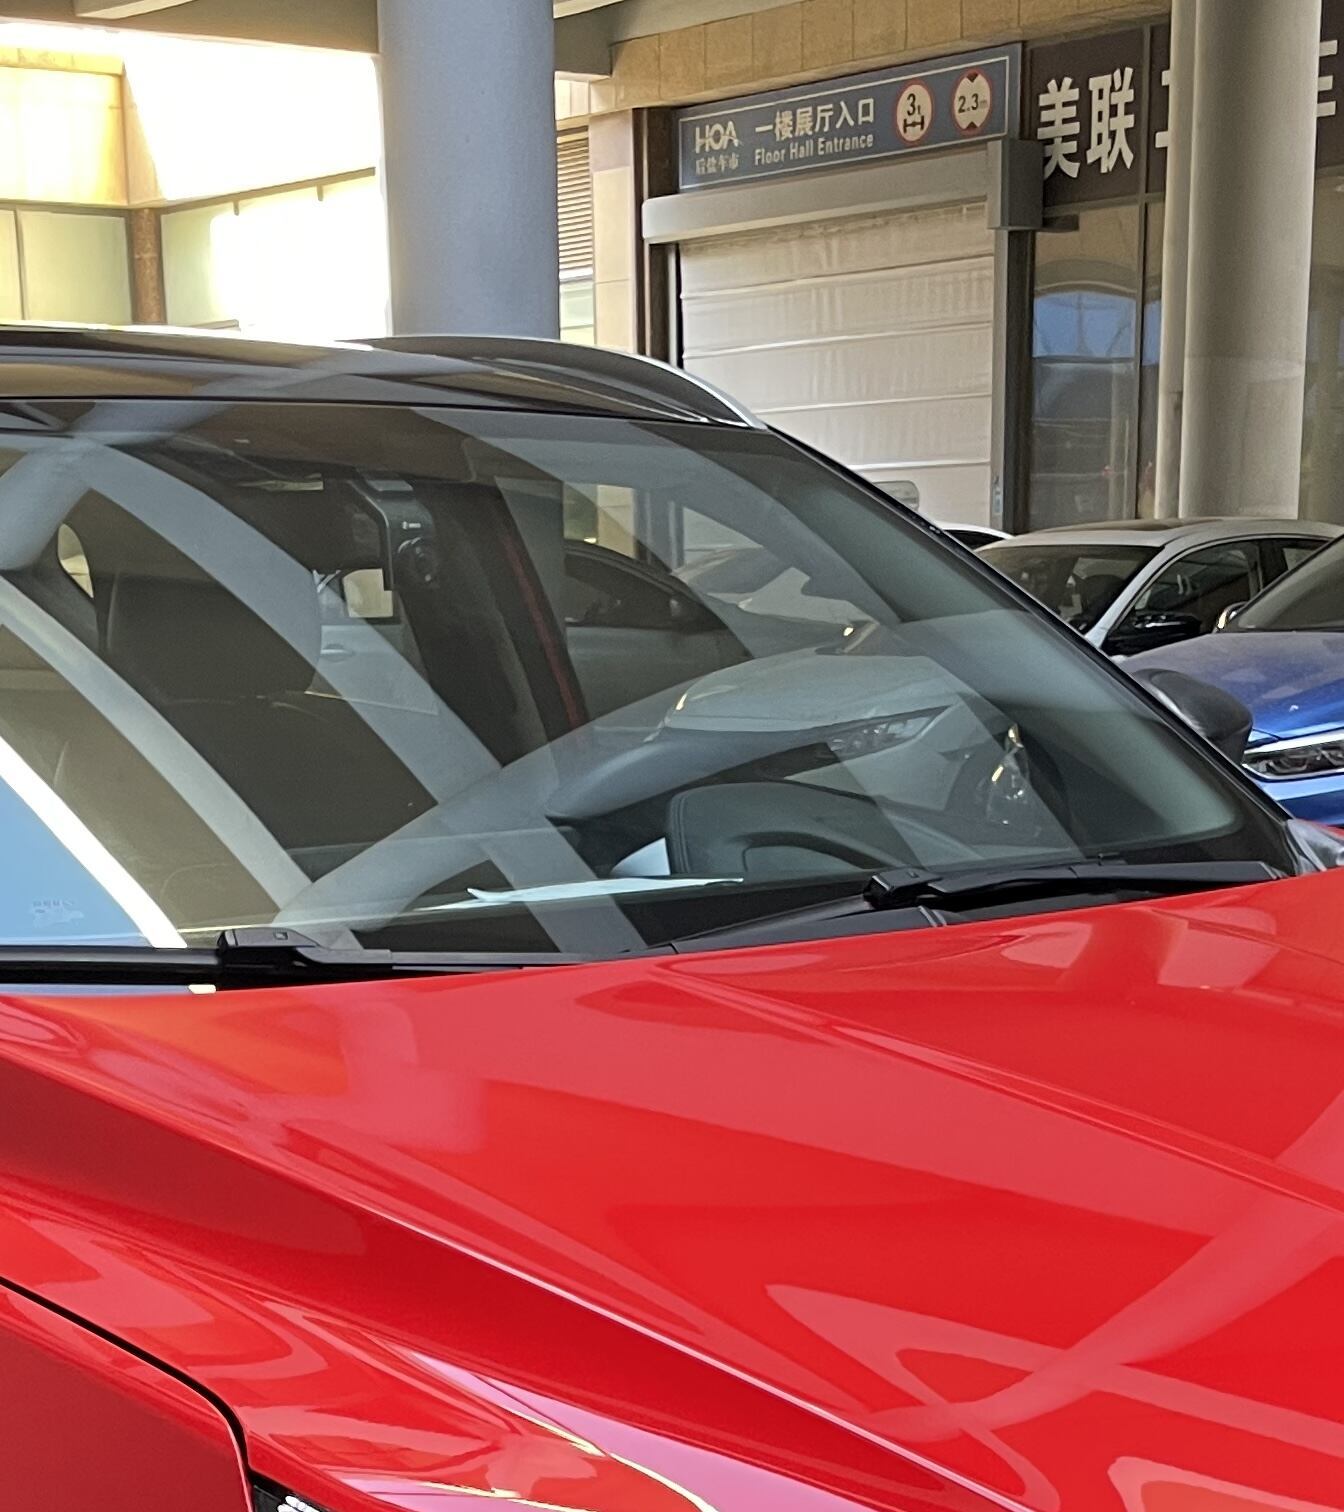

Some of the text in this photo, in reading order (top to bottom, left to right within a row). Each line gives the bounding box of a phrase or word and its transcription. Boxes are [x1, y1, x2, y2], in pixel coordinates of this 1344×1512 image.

[755, 98, 874, 141] 一楼展厅入口
[1036, 67, 1171, 179] 美联
[755, 133, 873, 165] Floor Hall Entrance
